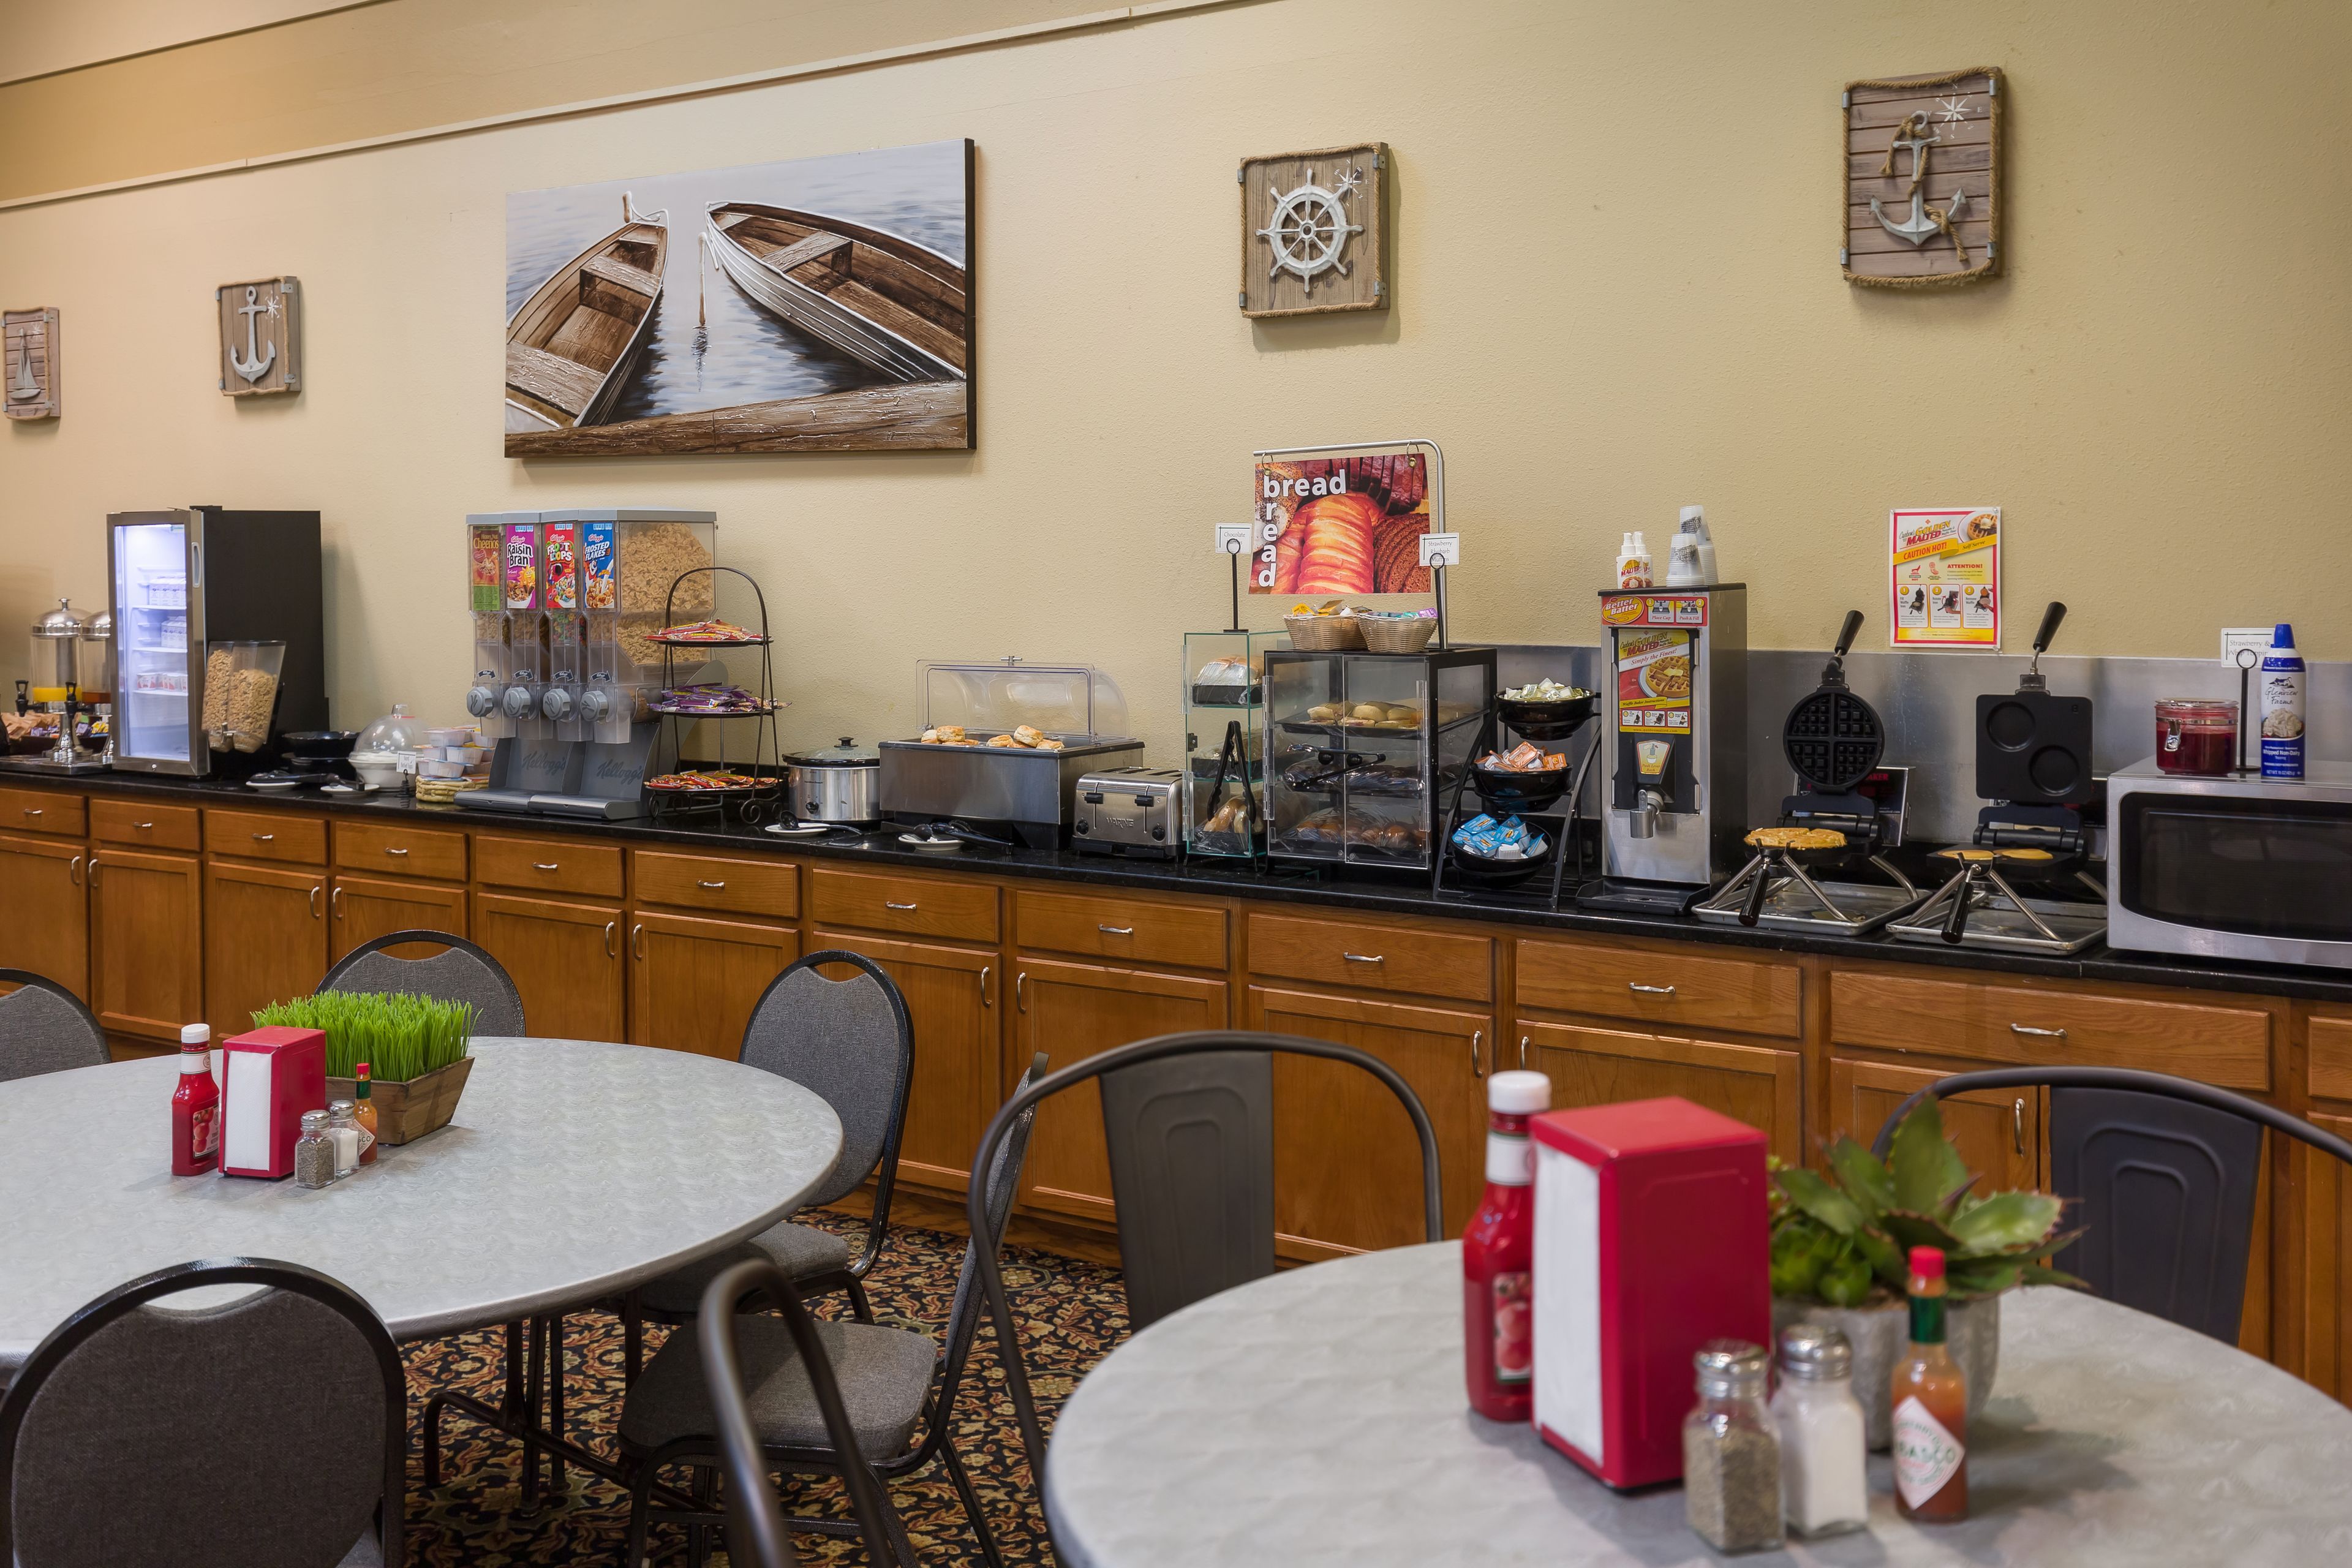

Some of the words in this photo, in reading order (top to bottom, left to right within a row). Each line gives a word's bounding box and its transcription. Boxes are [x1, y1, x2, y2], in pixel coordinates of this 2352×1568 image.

[1264, 469, 1346, 498] bread
[1915, 520, 1951, 537] GOLDEN
[473, 538, 499, 549] Cheerios
[1906, 530, 1942, 546] MALTED
[507, 543, 533, 557] Raisin
[548, 542, 570, 555] FROOT
[585, 541, 610, 554] FROSTED
[1904, 547, 1931, 560] CAUTION
[1932, 542, 1947, 552] HOT!
[509, 554, 530, 567] Bran
[550, 551, 573, 562] LOOPS
[585, 549, 606, 562] FLAKES
[1605, 598, 1633, 611] Better
[1610, 603, 1638, 616] Batter
[1635, 632, 1668, 646] GOLDEN
[1627, 641, 1660, 656] MALTED
[1631, 656, 1649, 665] Simply
[1659, 648, 1677, 657] Finest!
[522, 751, 567, 776] Kellogg's
[597, 759, 644, 785] Kellogg's
[1106, 817, 1134, 829] WARING
